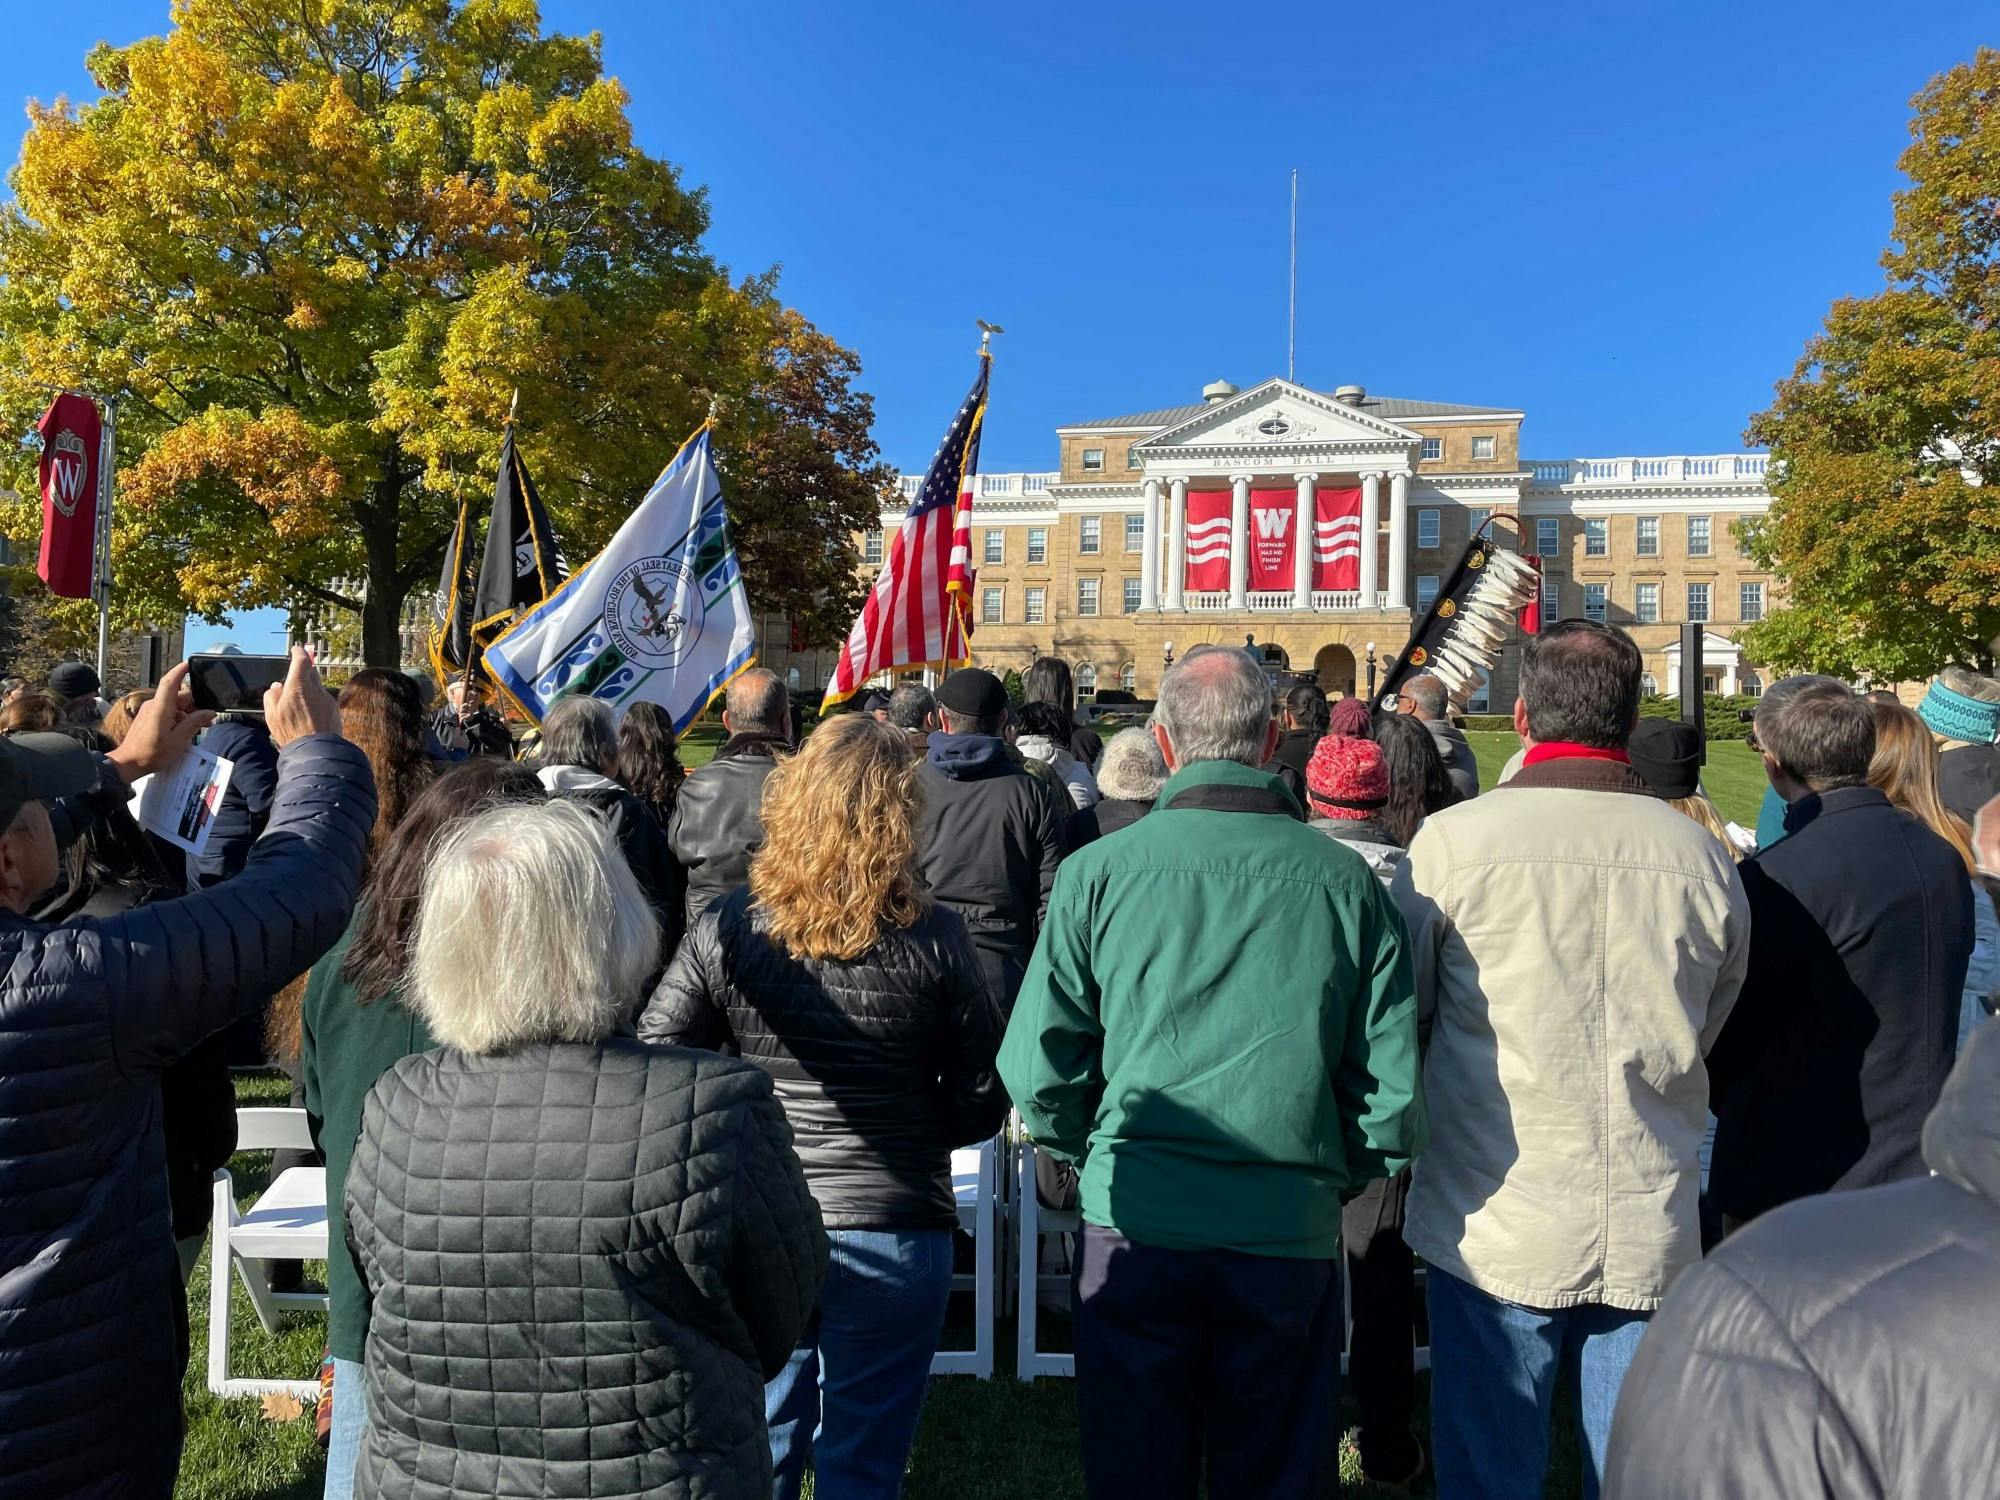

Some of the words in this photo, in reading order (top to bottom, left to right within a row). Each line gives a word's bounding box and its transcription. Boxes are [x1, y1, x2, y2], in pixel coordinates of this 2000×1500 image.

[1213, 458, 1273, 466] BASCOM
[54, 458, 81, 500] W
[1253, 508, 1293, 539] W
